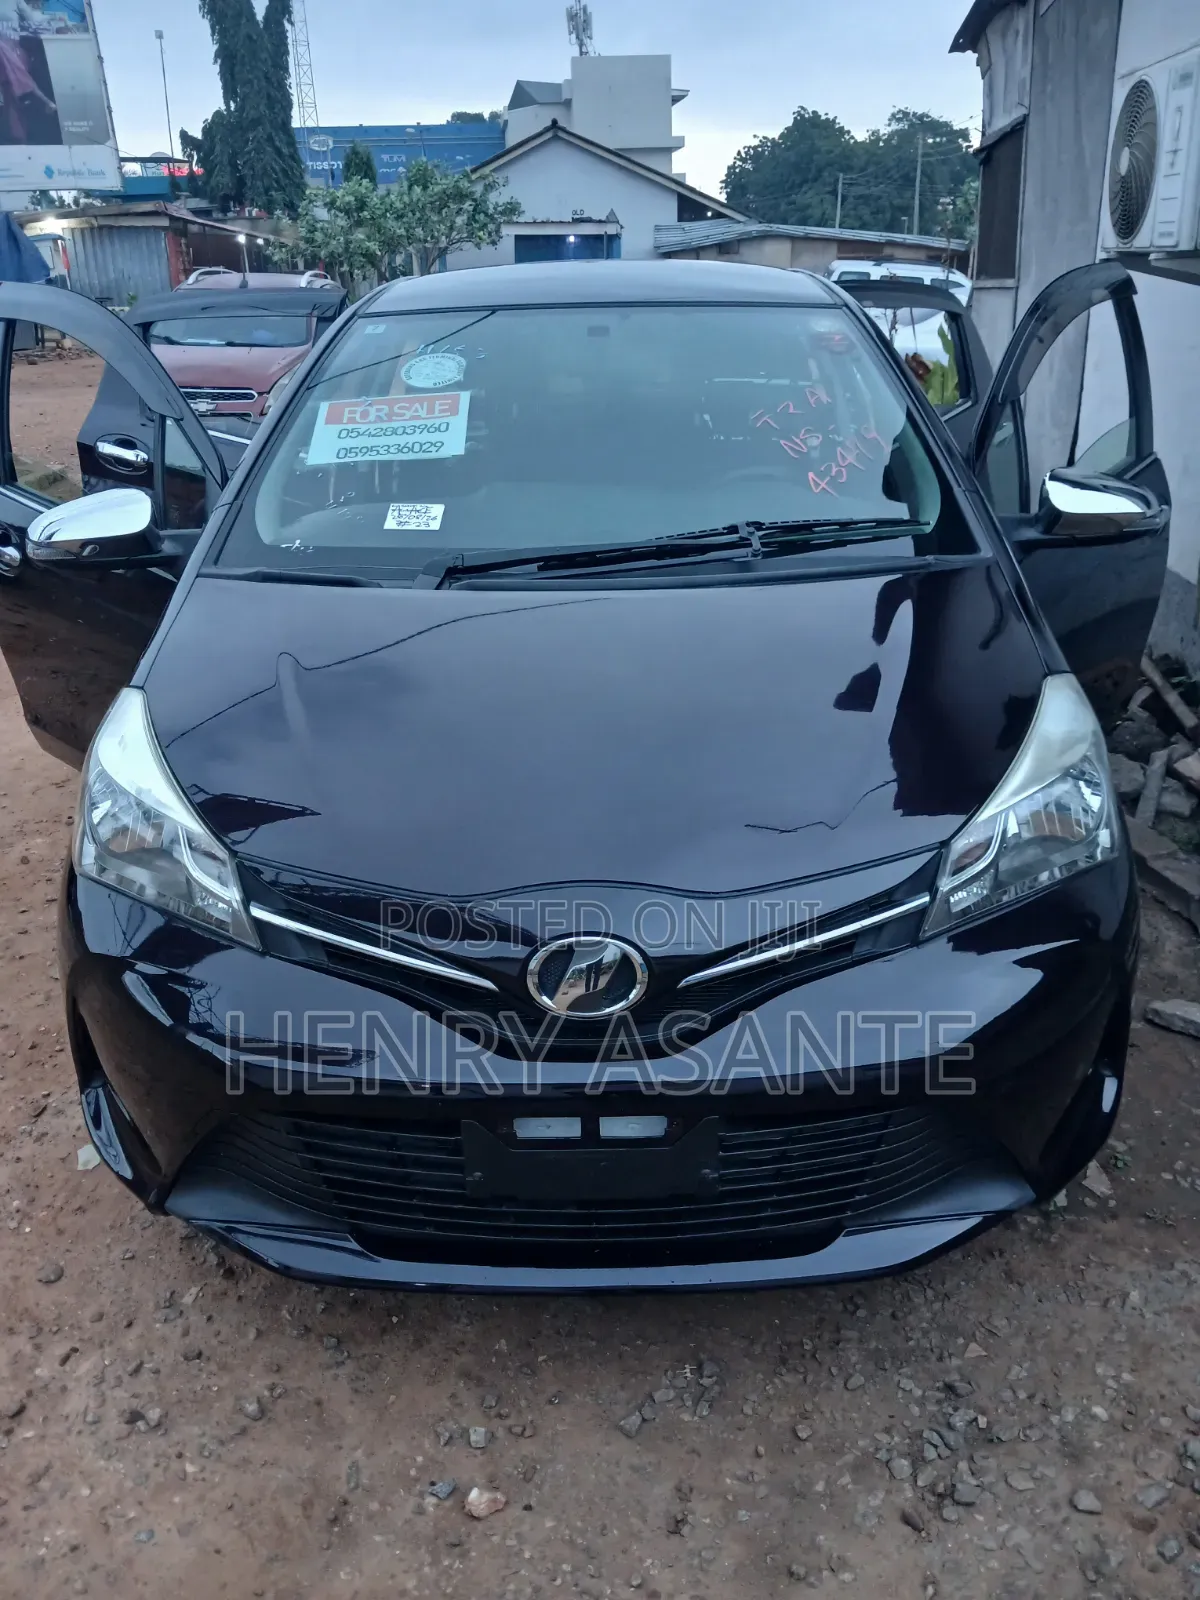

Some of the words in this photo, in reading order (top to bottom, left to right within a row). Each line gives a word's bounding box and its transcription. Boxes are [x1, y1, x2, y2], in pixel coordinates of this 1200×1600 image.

[342, 402, 390, 424] FOR
[391, 399, 453, 420] SALE
[337, 421, 450, 440] 0542803960
[335, 440, 445, 460] 0595336029
